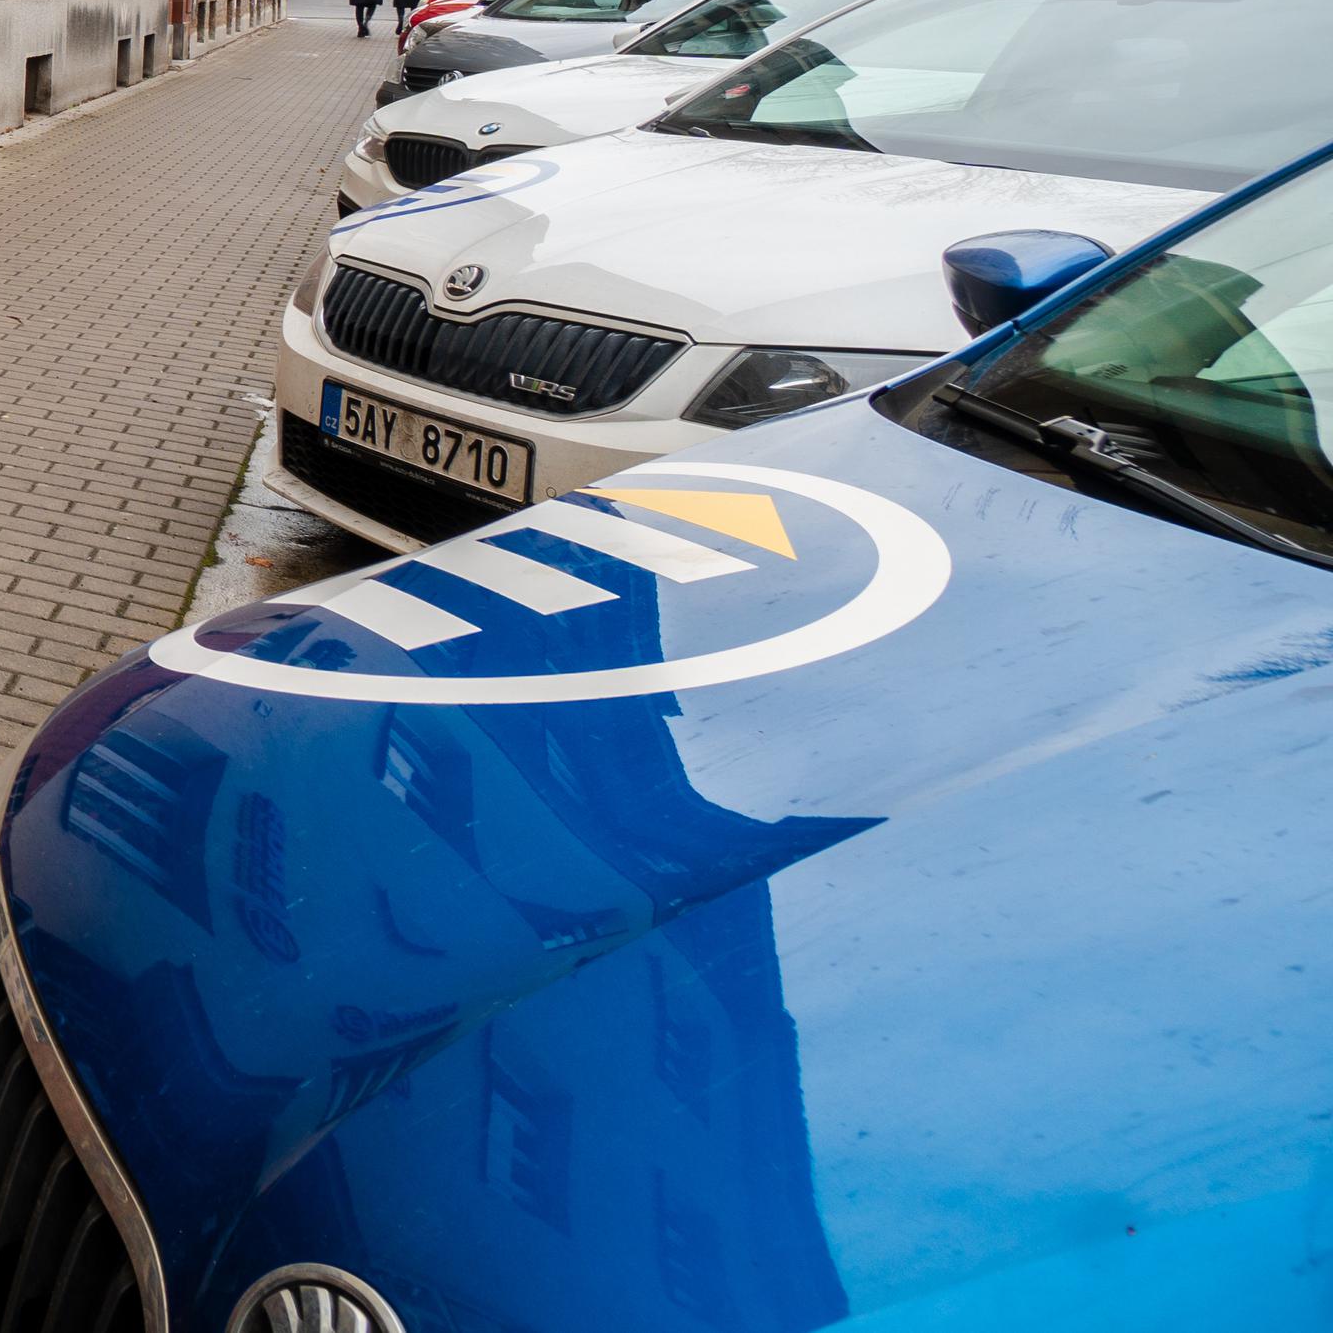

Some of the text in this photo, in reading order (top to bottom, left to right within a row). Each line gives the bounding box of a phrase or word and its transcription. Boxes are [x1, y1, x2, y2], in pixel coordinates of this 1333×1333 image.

[325, 415, 337, 429] CZ
[345, 396, 509, 488] 5AY 8710
